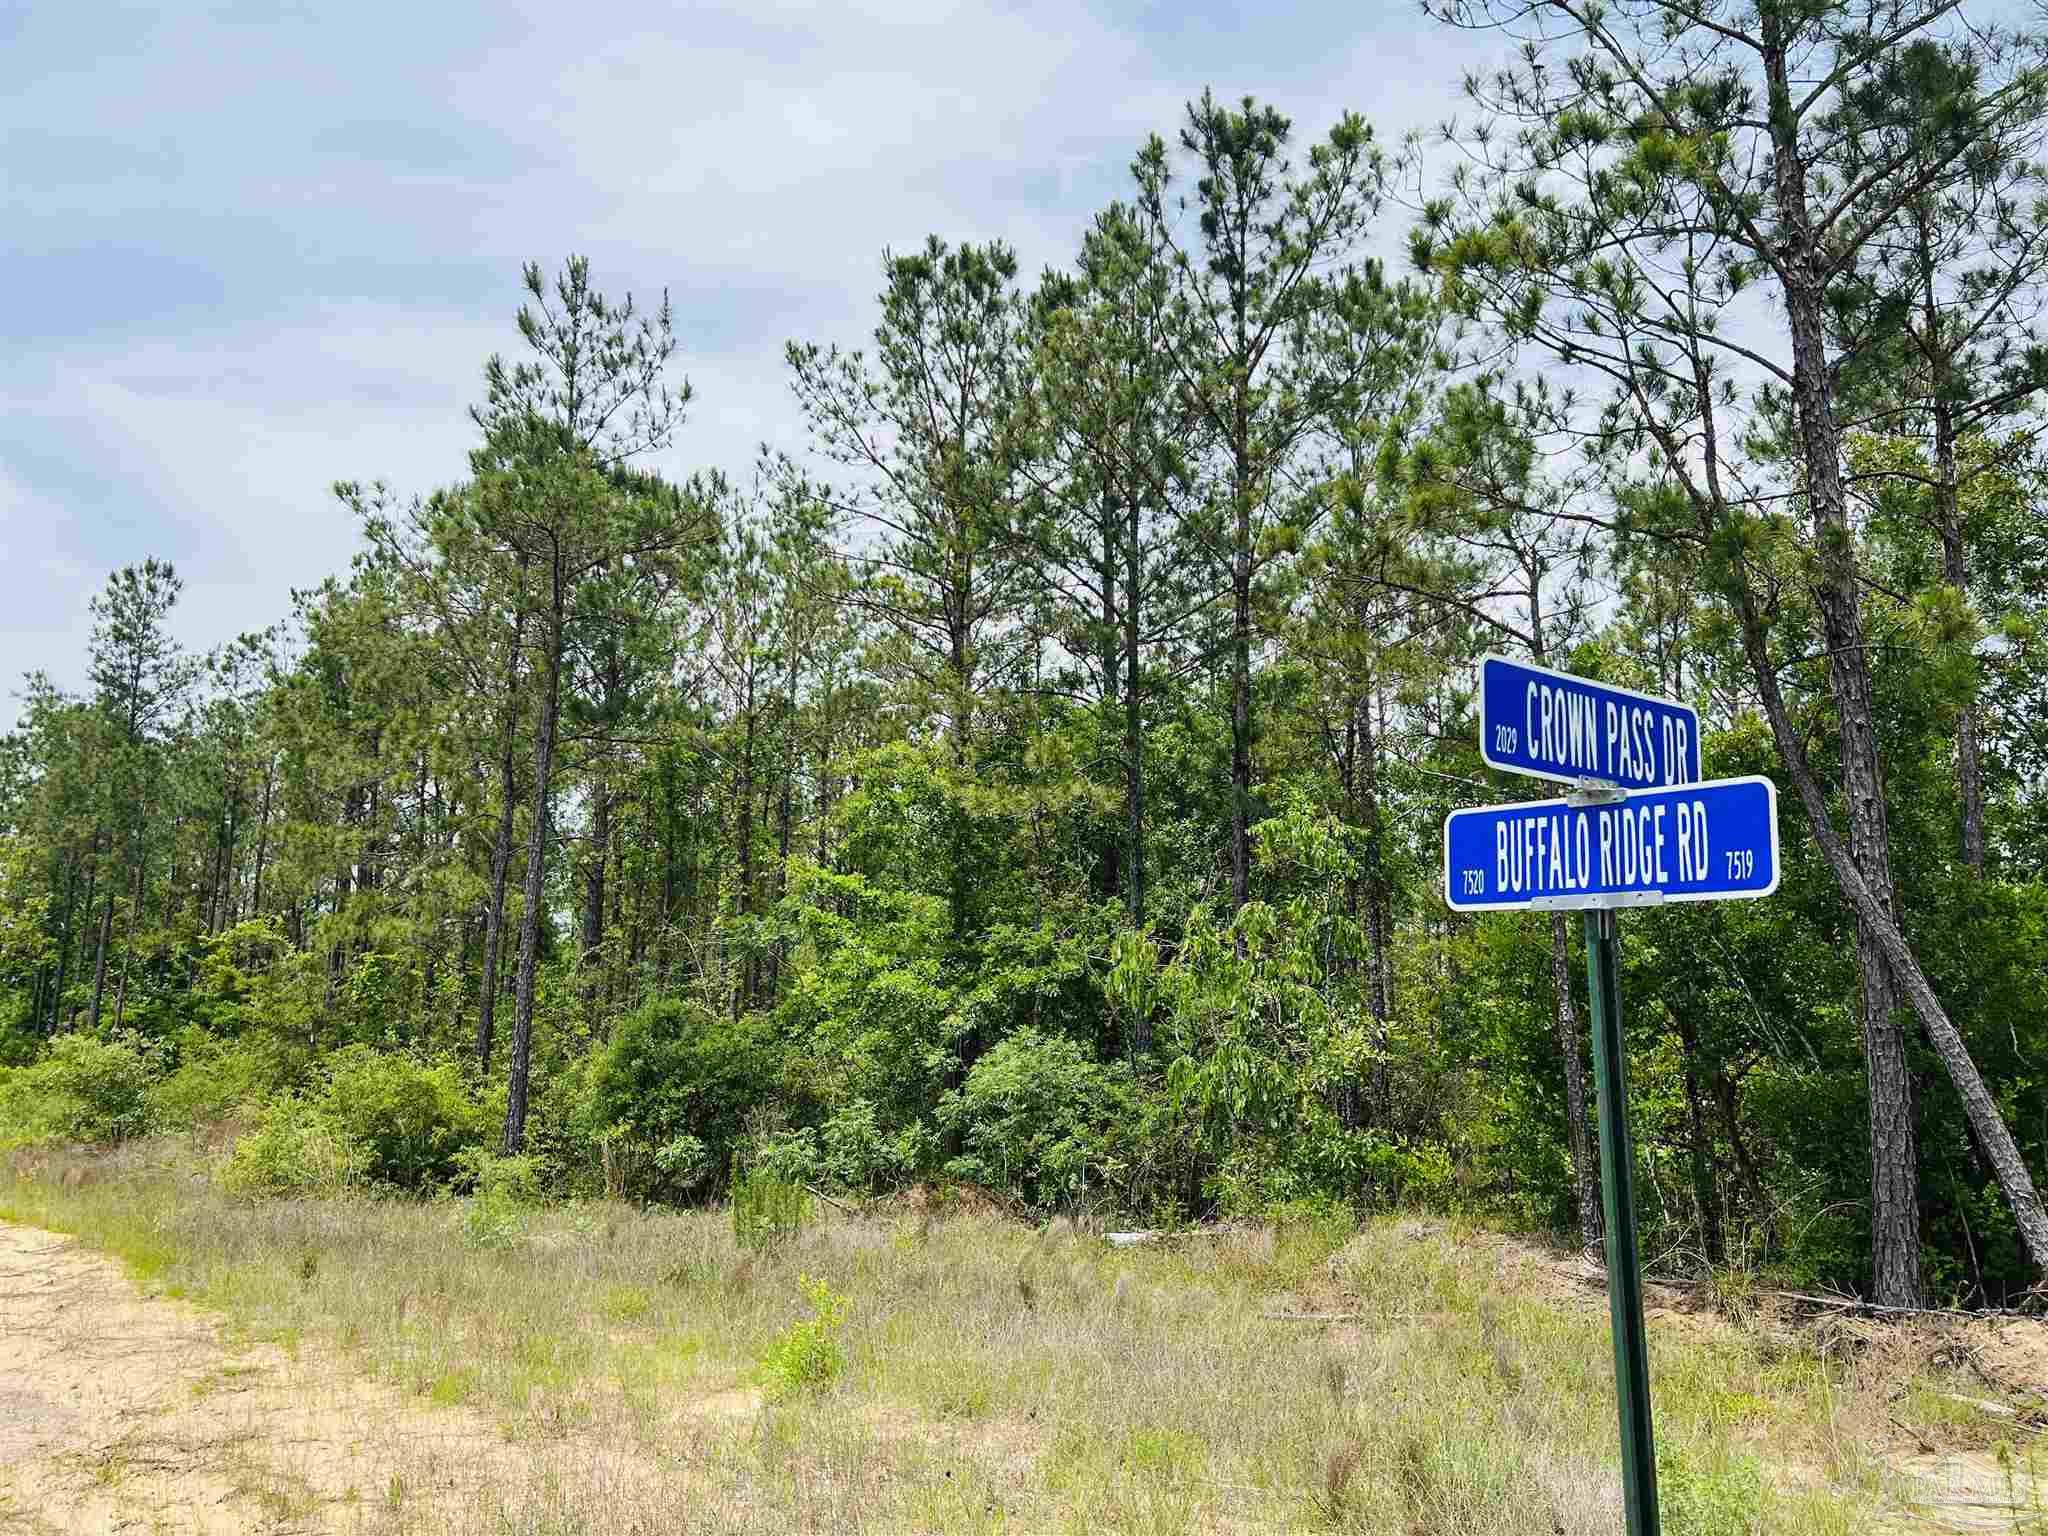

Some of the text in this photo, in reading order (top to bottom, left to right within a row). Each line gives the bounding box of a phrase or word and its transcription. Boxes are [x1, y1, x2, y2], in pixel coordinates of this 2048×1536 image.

[1495, 680, 1689, 786] 2029 CROWN PASS DR
[1463, 801, 1753, 896] 7520 BUFFALO RIDGE RD 7519
